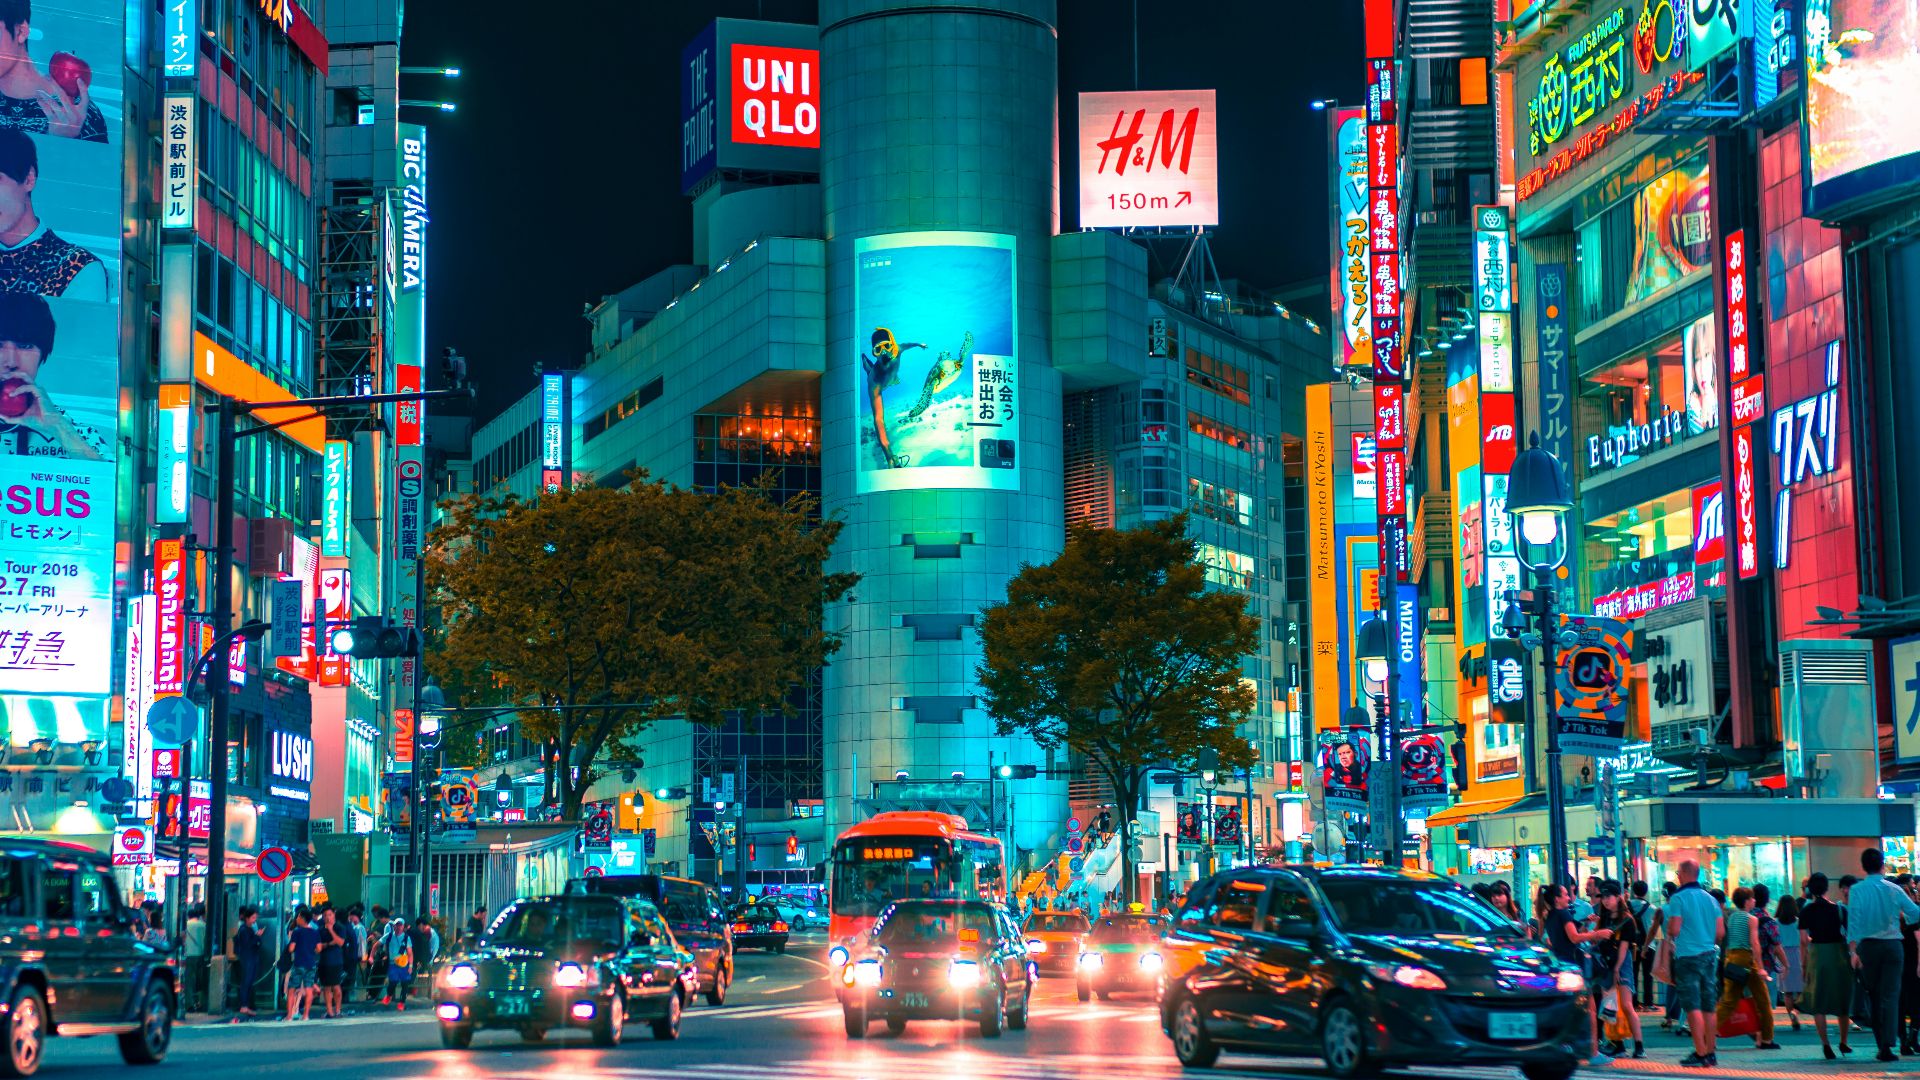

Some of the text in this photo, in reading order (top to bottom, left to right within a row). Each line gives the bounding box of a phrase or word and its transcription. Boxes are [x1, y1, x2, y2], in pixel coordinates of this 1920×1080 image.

[172, 66, 187, 76] 6F
[690, 48, 708, 110] THE
[743, 57, 810, 95] UNI
[1570, 35, 1625, 128] 西村
[684, 99, 714, 173] PRIME
[743, 98, 817, 138] QLO
[170, 105, 187, 217] 渋谷駅前ビル
[1097, 108, 1199, 176] H&M
[403, 138, 430, 289] BIC CAMERA
[1107, 193, 1168, 210] 150m
[1378, 191, 1389, 199] 7F
[1379, 256, 1391, 264] 7F
[1380, 320, 1393, 330] 6F
[1731, 241, 1747, 373] お好み焼
[978, 369, 1014, 384] 世界に
[1382, 388, 1394, 397] 6F
[546, 377, 559, 421] THE PRIME
[1542, 323, 1570, 488] サマーフルー
[1486, 425, 1513, 443] JTB
[1588, 403, 1683, 468] Euphoria
[1773, 387, 1838, 486] クスリ
[325, 446, 341, 487] レイク
[1384, 454, 1397, 463] 6F
[31, 473, 91, 485] NEW SINGLE
[401, 462, 420, 497] OS
[0, 484, 91, 519] sus
[1489, 497, 1501, 537] パーラー
[1738, 434, 1755, 571] もんじゃ焼
[402, 500, 417, 561] 調剤薬局
[1316, 491, 1328, 580] Matsumoto
[5, 561, 78, 577] Tour 2018
[0, 603, 88, 618] ーパーアリーナ
[33, 586, 55, 597] FRI
[159, 582, 180, 683] サンドラッグ
[285, 586, 299, 651] 渋谷駅前
[1400, 600, 1414, 663] MIZUHO
[325, 666, 338, 676] 3F
[1498, 657, 1523, 702] HUB
[272, 730, 312, 782] LUSH
[124, 836, 143, 845] ガスト
